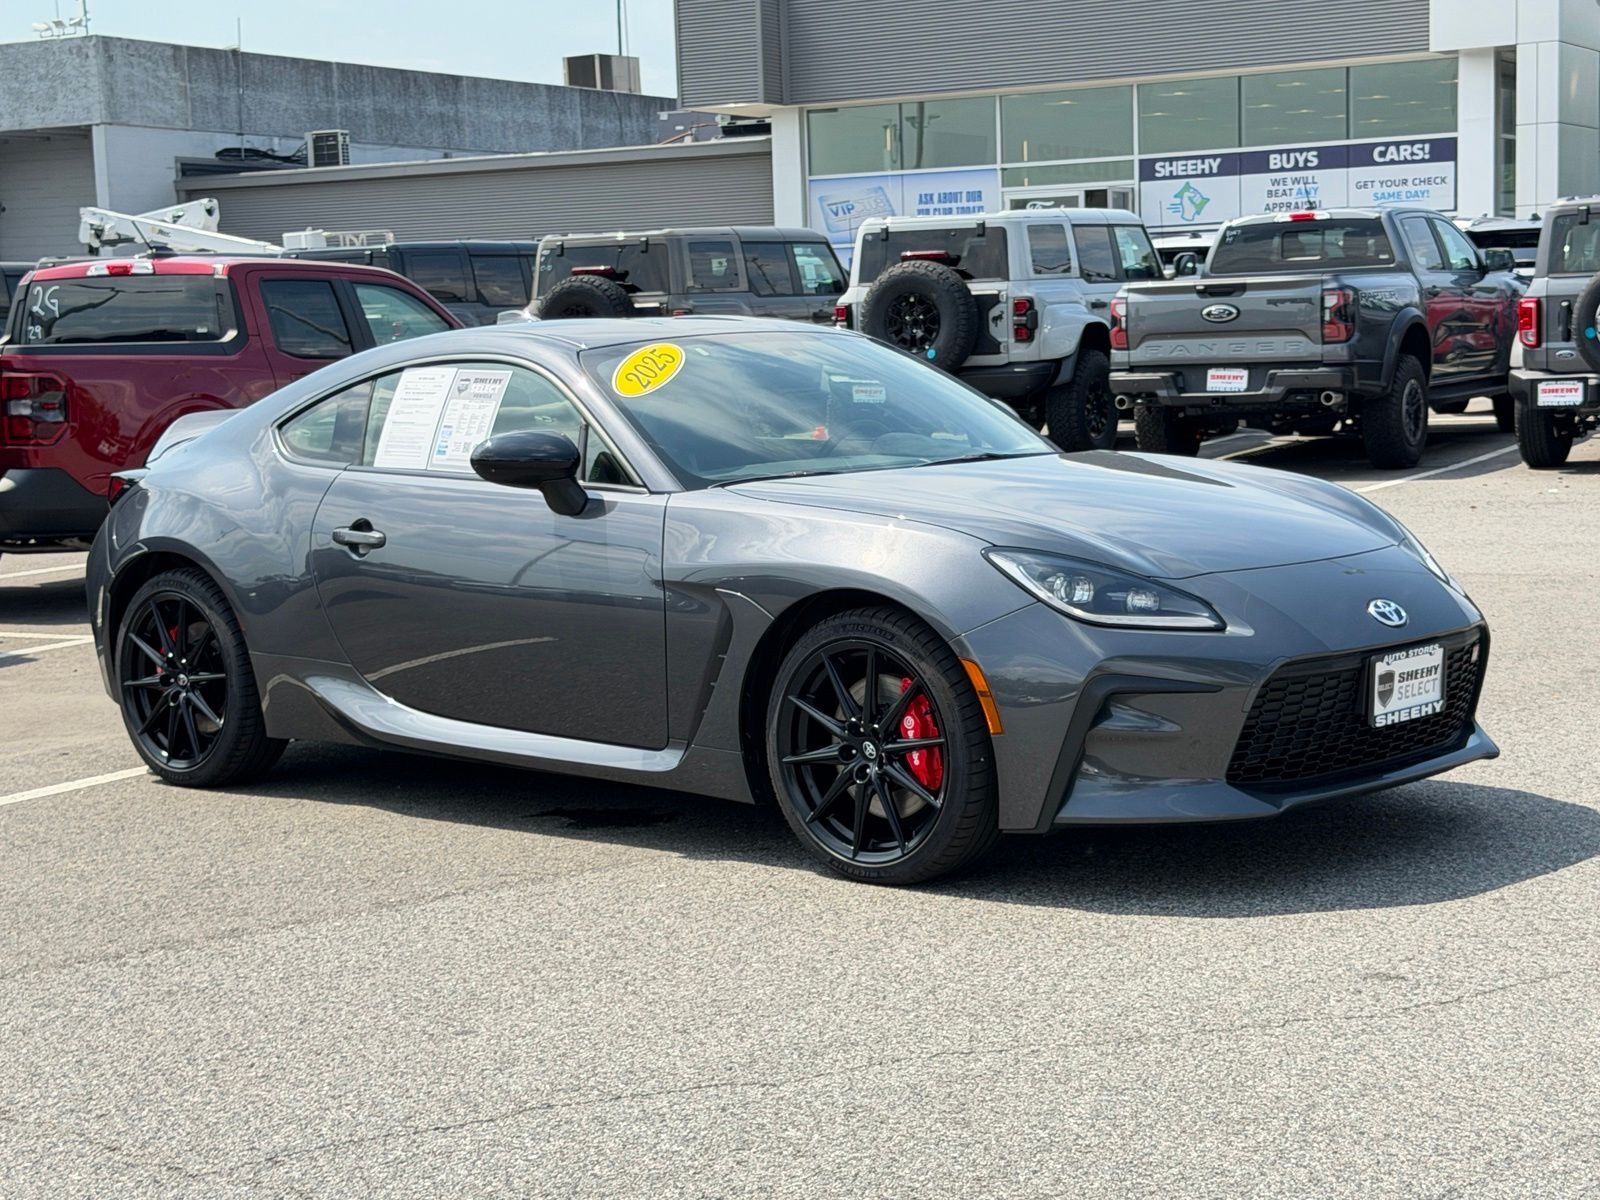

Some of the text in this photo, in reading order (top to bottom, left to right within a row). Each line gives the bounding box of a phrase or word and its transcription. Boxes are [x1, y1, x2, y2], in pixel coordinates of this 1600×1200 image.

[1269, 151, 1319, 170] BUYS
[1373, 143, 1431, 162] CARS!
[1154, 158, 1222, 178] SHEEHY
[1270, 176, 1318, 187] WE WILL
[1355, 176, 1447, 190] GET YOUR CHECK
[918, 190, 983, 205] ASK ABOUT OUR
[1266, 186, 1319, 198] BEAT ANY
[1372, 189, 1430, 201] SAME DAY!
[829, 203, 855, 217] VIP
[1145, 340, 1304, 357] RANGER
[625, 348, 676, 389] 2025
[1383, 644, 1440, 663] AUTO STORES
[1398, 664, 1440, 683] SHEEHY
[1397, 678, 1438, 700] SELECT
[1375, 700, 1443, 728] SHEEHY
